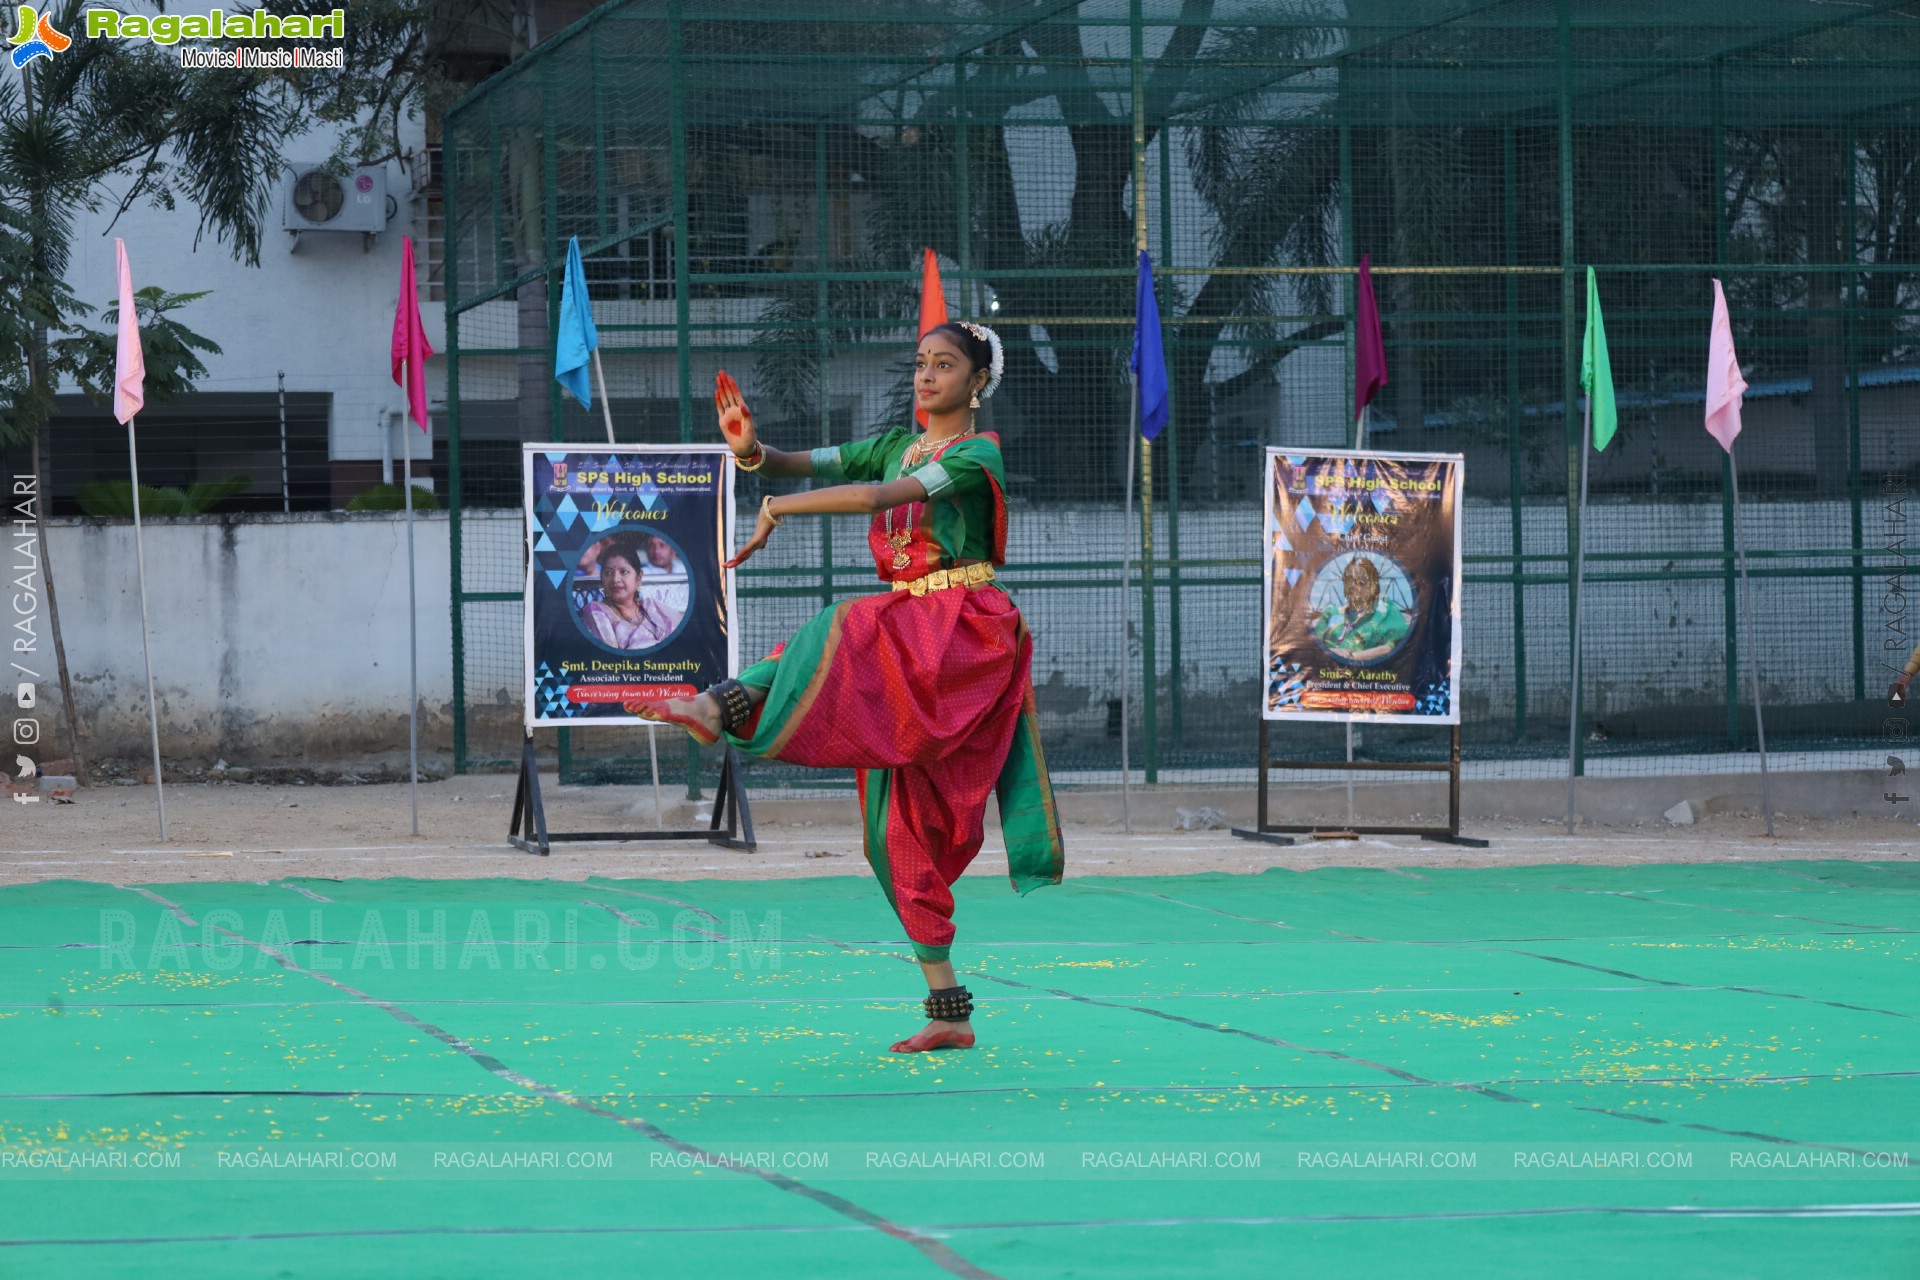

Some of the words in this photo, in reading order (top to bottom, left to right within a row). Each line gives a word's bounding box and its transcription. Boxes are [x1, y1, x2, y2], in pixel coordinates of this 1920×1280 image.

[357, 195, 371, 204] LG
[576, 471, 609, 484] SPS
[614, 471, 652, 487] High
[656, 471, 712, 484] School
[1315, 476, 1345, 488] SPS
[1349, 477, 1385, 491] High
[1389, 478, 1442, 491] School
[592, 500, 669, 521] Welcomes
[1363, 533, 1389, 543] Guest
[562, 660, 588, 672] Smt.
[591, 660, 640, 673] Deepika
[643, 660, 701, 673] Sampathy
[580, 673, 620, 683] Associate
[623, 674, 641, 682] Vice
[643, 674, 684, 682] President
[1357, 670, 1398, 683] Aarathy
[1306, 680, 1341, 690] President
[1343, 682, 1350, 690] &
[1351, 682, 1373, 690] Chief
[1374, 683, 1411, 691] Executive
